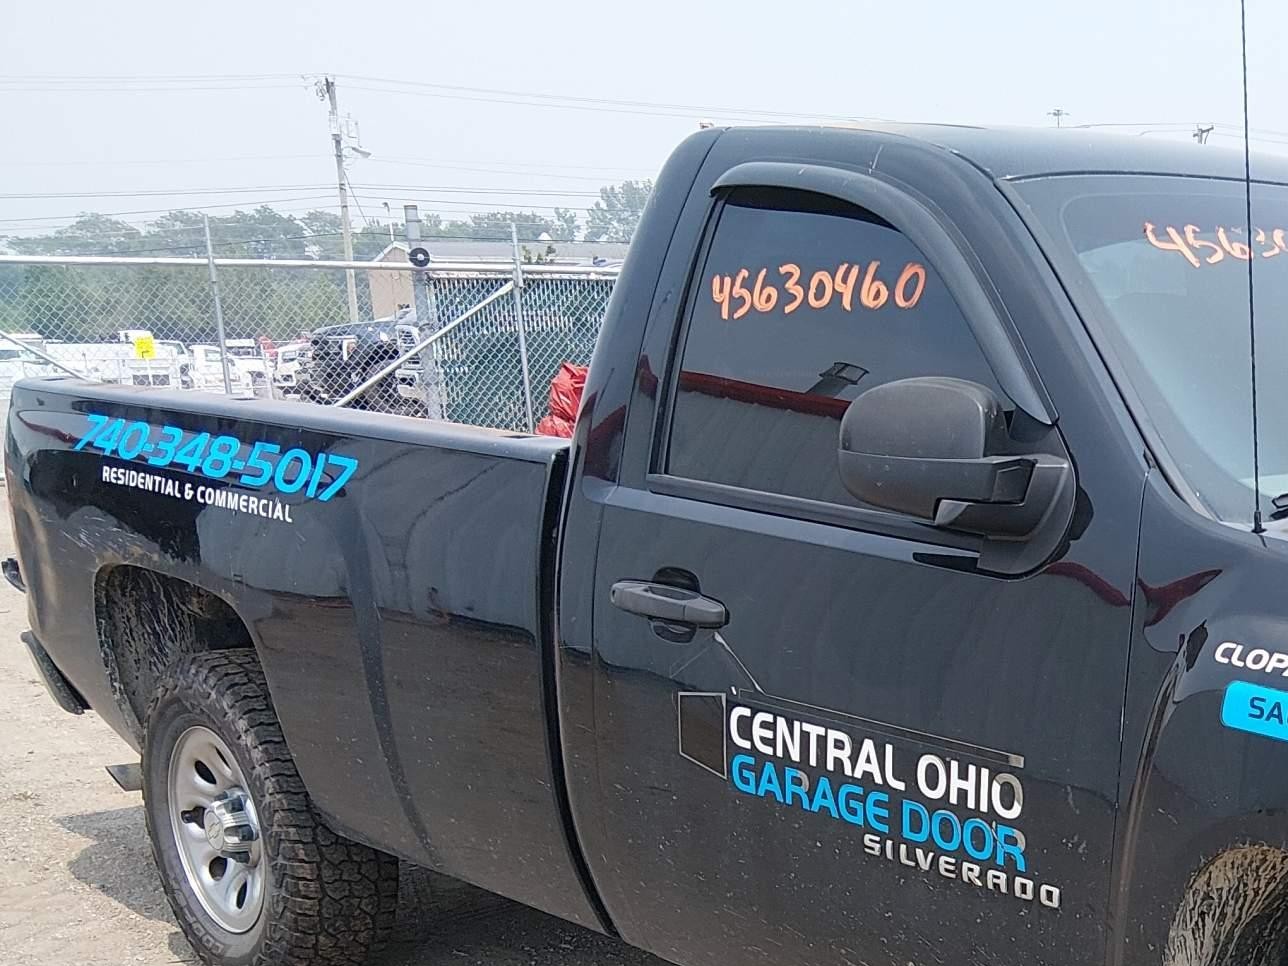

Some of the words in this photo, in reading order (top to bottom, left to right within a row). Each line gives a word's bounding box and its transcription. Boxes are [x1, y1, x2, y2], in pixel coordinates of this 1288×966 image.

[712, 261, 926, 320] 45630460
[73, 413, 359, 501] 740-348-5017
[102, 465, 182, 498] RESIDENTIAL
[184, 483, 195, 500] &
[196, 485, 293, 523] COMMERCIAL
[729, 706, 906, 791] CENTRAL
[916, 753, 1024, 819] OHIO
[731, 753, 889, 833] GARAGE
[901, 800, 1026, 872] DOOR
[863, 833, 1061, 909] SILVERADO
